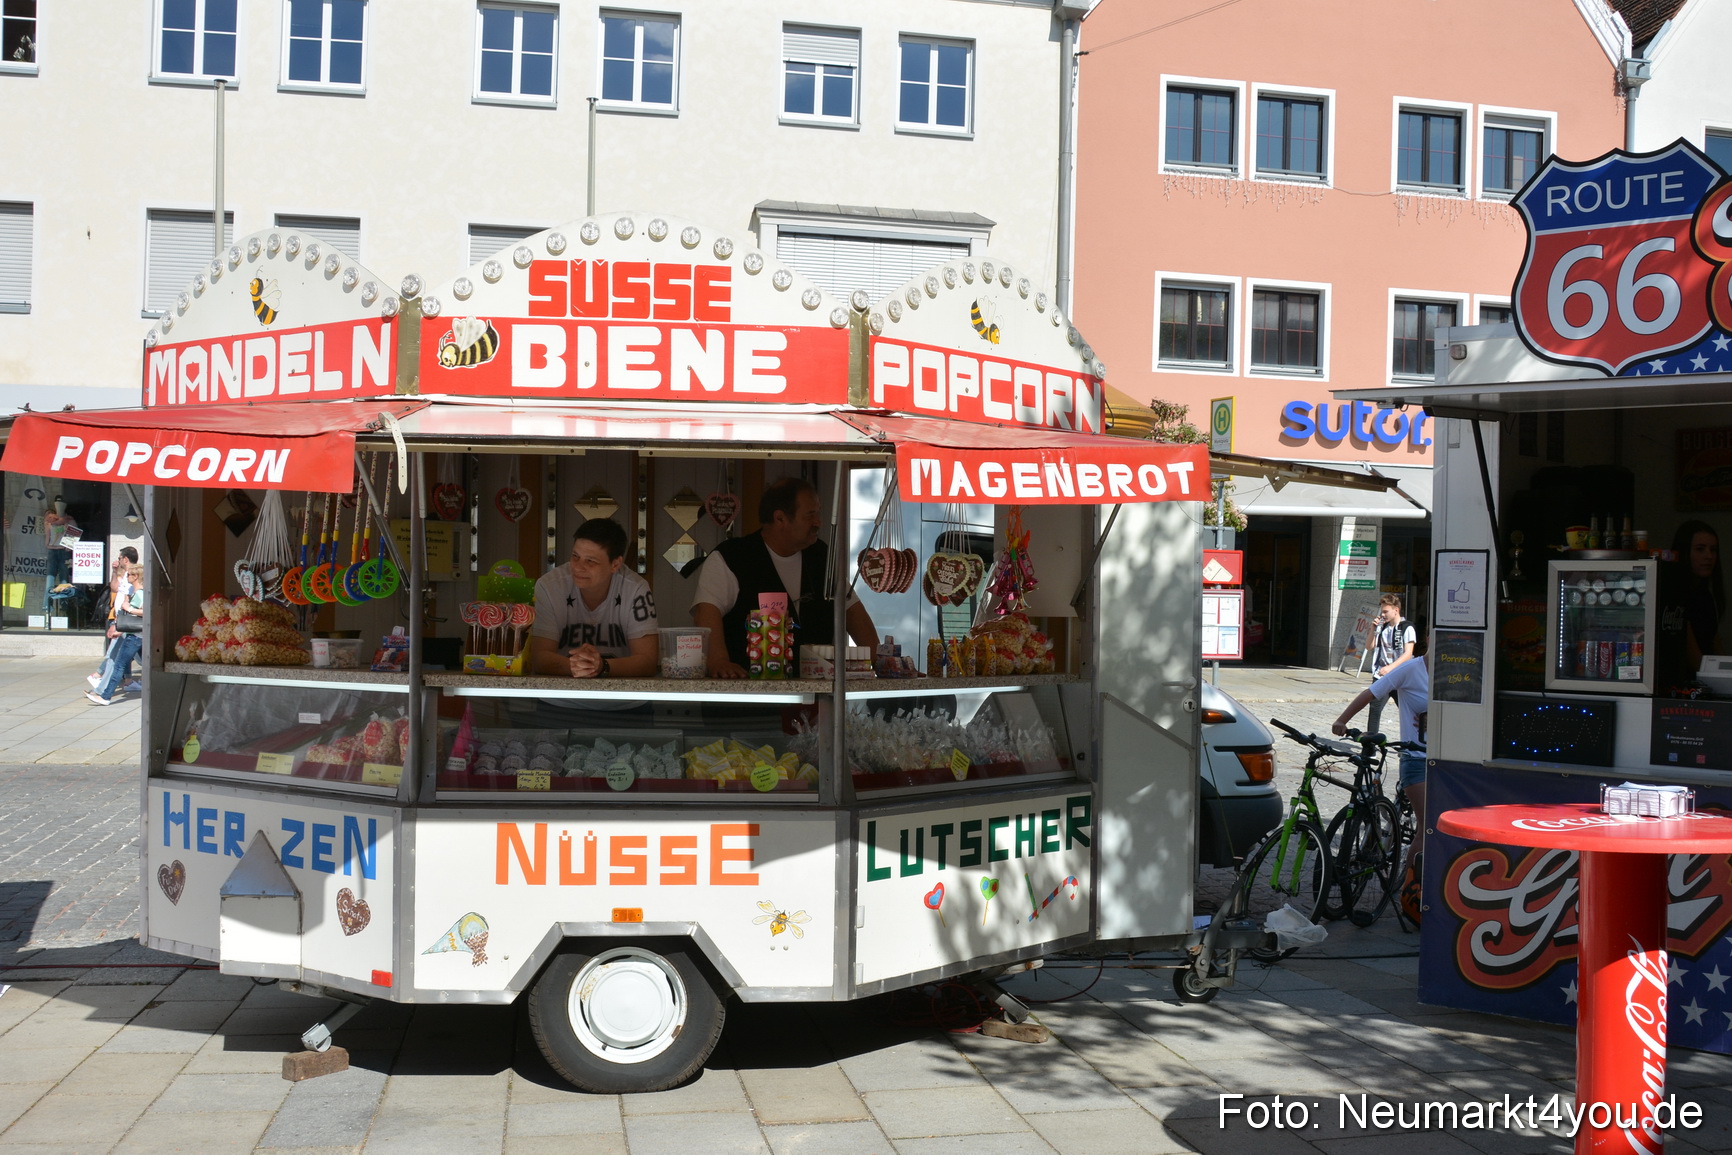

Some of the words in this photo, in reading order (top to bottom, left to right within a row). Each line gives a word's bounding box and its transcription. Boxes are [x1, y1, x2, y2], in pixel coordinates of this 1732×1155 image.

[1546, 170, 1686, 217] ROUTE
[528, 259, 732, 322] SÜSSE
[1547, 237, 1683, 341] 66
[148, 323, 391, 406] MANDELN
[511, 324, 788, 394] BIENE
[873, 342, 1102, 433] POPCORN
[50, 435, 292, 484] POPCORN
[910, 457, 1195, 498] MAGENBROT
[16, 557, 49, 566] NORG
[558, 623, 627, 650] BERLIN
[1441, 653, 1477, 665] Pommes
[1501, 714, 1605, 747] OPEN
[496, 822, 760, 886] NÜSSE
[866, 796, 1092, 882] LUTSCHER
